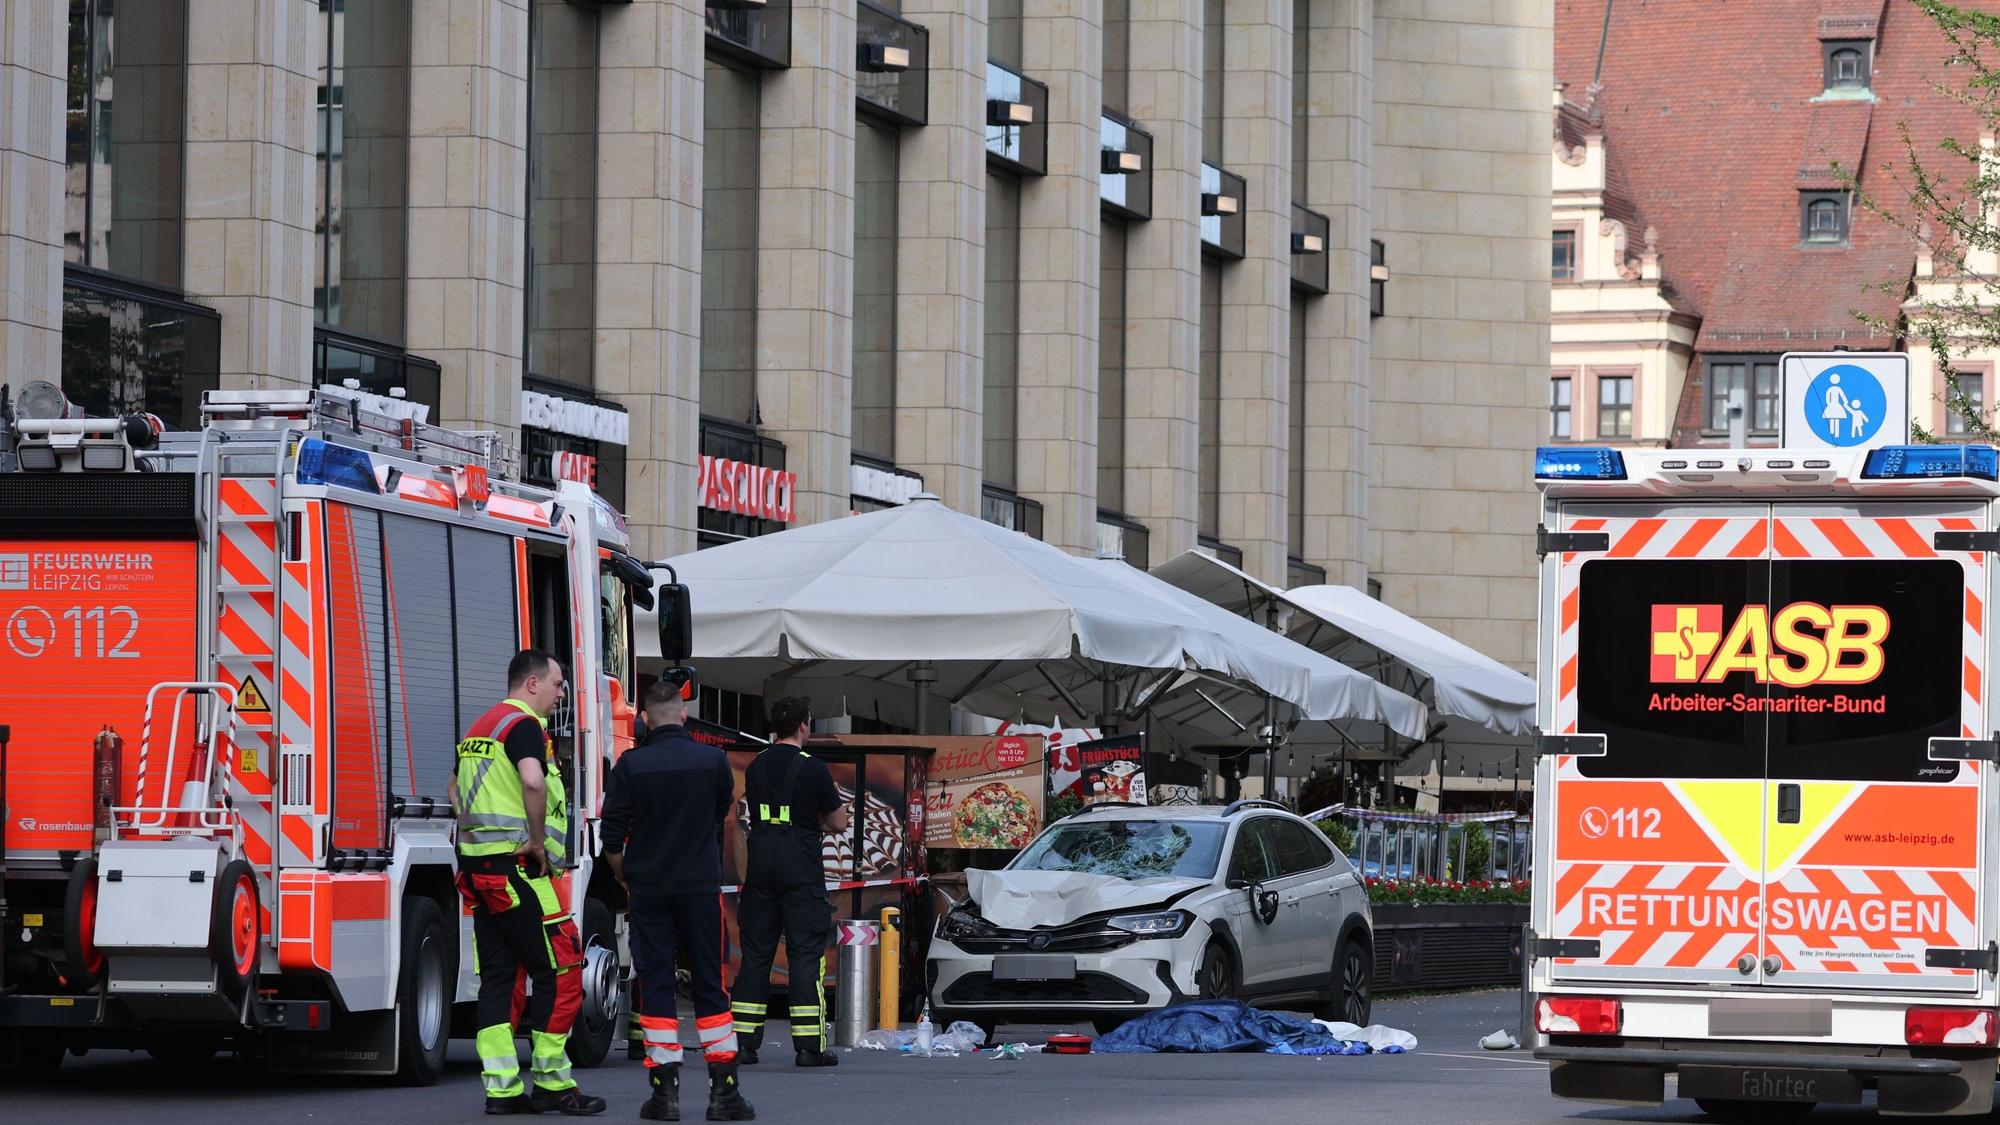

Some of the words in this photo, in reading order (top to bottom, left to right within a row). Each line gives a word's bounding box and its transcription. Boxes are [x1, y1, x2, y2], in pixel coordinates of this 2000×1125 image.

[33, 553, 153, 570] FEUERWEHR
[33, 574, 101, 591] LEIPZIG
[63, 605, 141, 658] 112
[1700, 601, 1891, 688] ASB
[1648, 692, 1886, 713] Arbeiter-Samariter-Bund
[1611, 808, 1661, 839] 112
[1844, 832, 1955, 846] www.asb-leipzig.de
[1588, 893, 1942, 933] RETTUNGSWAGEN
[1742, 1070, 1816, 1098] fahrtec
